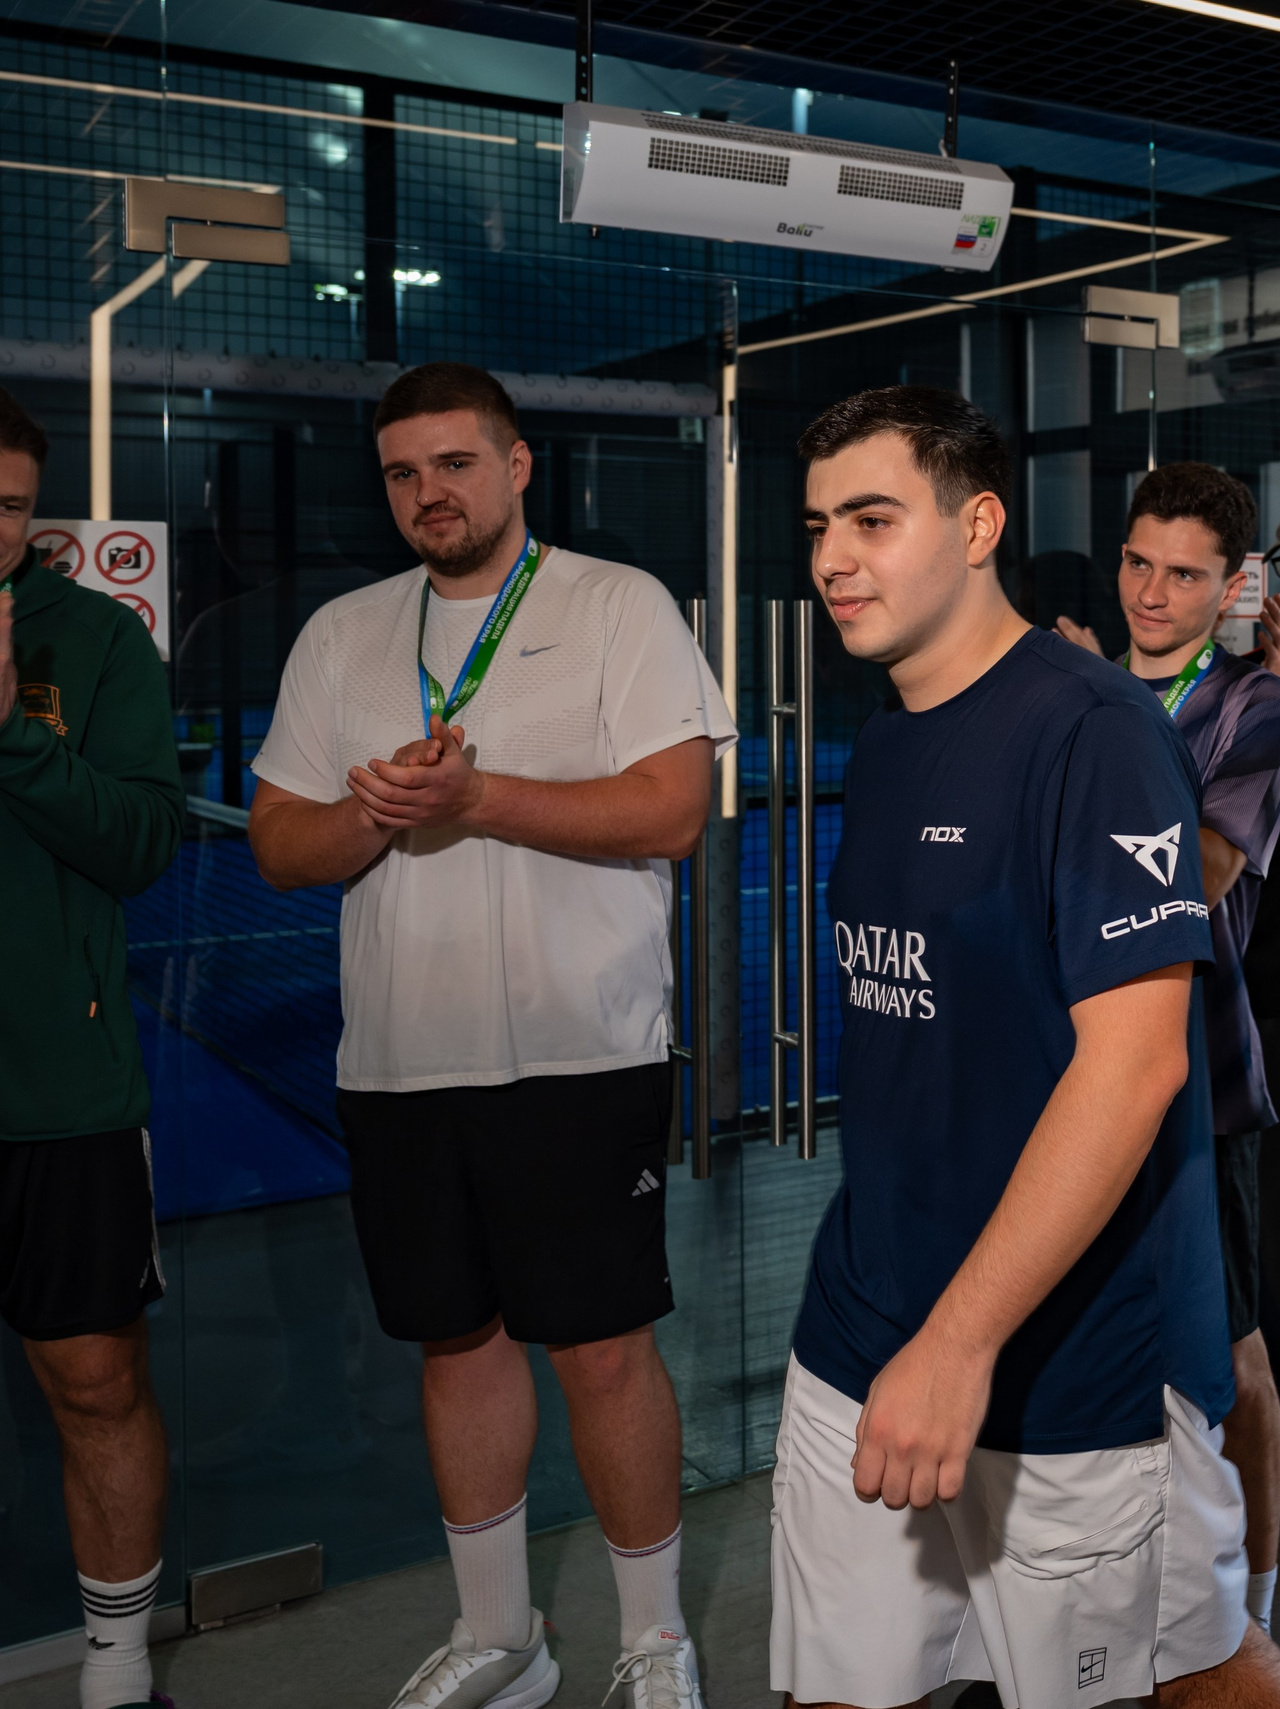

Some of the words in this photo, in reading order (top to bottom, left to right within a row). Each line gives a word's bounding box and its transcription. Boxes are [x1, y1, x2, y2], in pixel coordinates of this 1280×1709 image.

[776, 222, 813, 237] Ballu
[488, 560, 526, 626] КРАСНОДАРСКОГО
[506, 571, 531, 612] ФЕДЕРАЦИЯ
[479, 624, 494, 644] КРАЯ
[491, 610, 510, 640] ПАДЕЛА
[1164, 680, 1185, 708] ПАДЕЛА
[1181, 679, 1197, 696] КРАЯ
[1101, 900, 1209, 940] CUPRA
[835, 920, 932, 982] QATAR
[850, 976, 936, 1020] AIRWAYS
